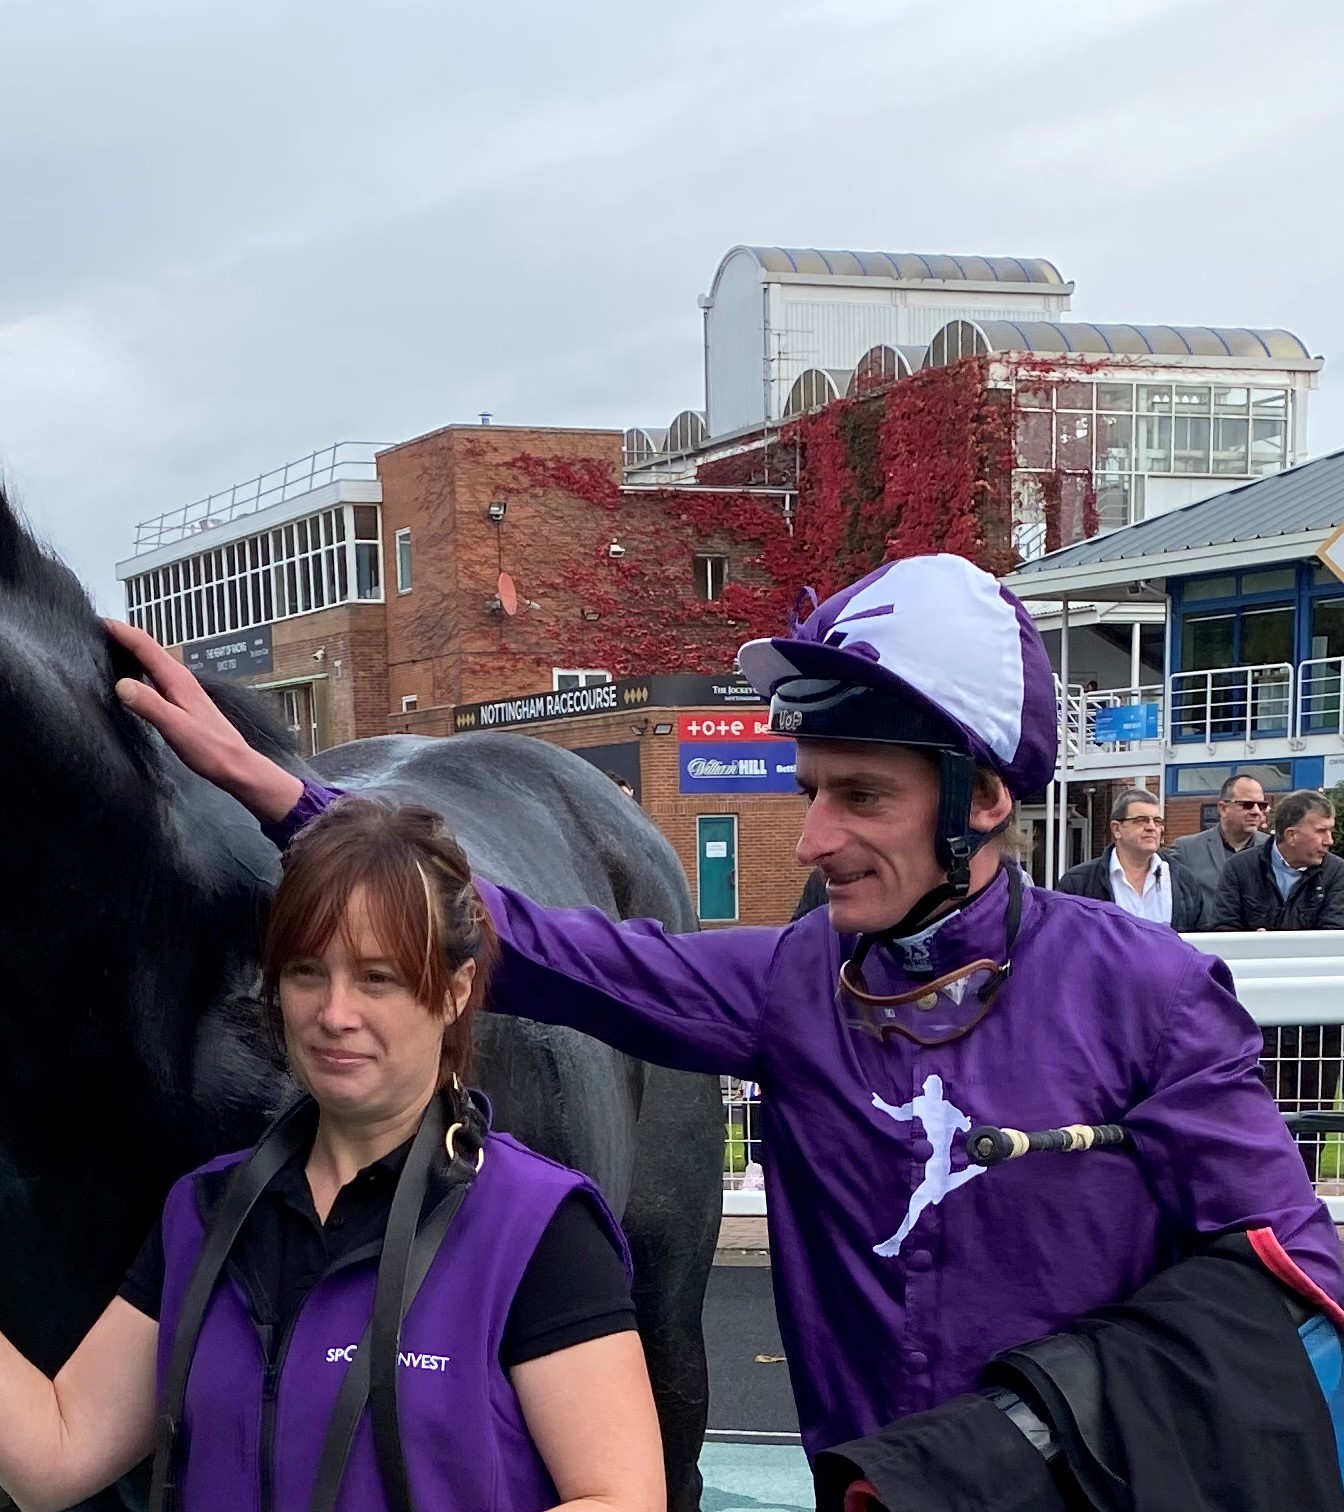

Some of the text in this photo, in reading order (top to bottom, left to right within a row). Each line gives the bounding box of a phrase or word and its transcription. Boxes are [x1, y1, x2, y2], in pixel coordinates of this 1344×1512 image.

[480, 685, 618, 726] NOTTINGHAM RACECOURSE
[687, 720, 745, 736] tote
[688, 758, 739, 778] William
[738, 759, 768, 775] HILL
